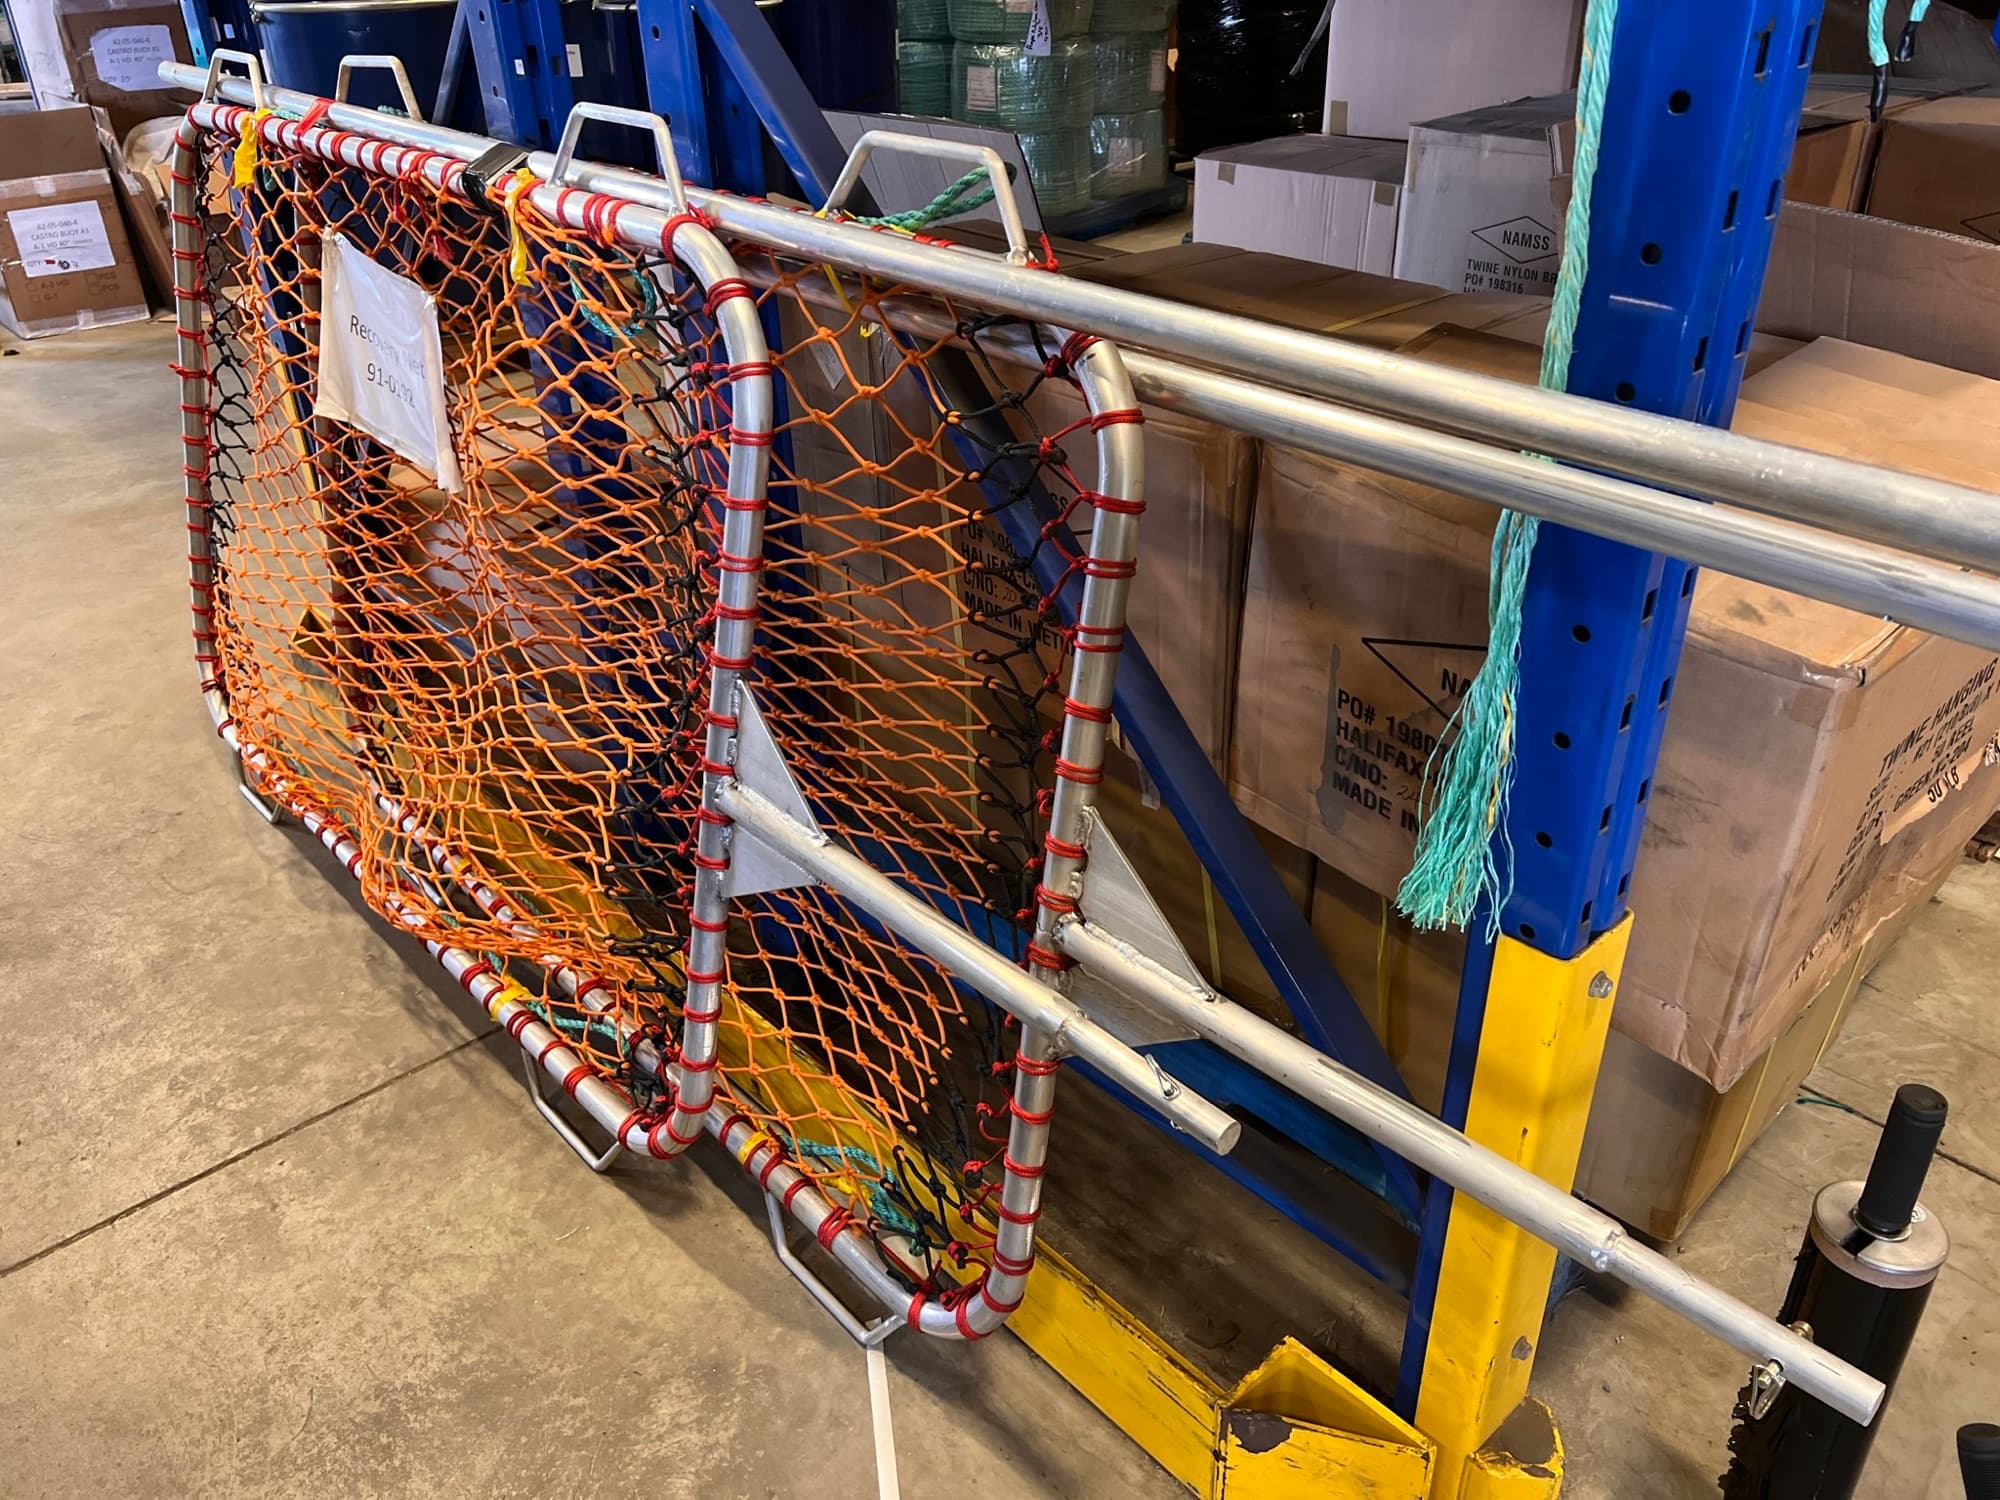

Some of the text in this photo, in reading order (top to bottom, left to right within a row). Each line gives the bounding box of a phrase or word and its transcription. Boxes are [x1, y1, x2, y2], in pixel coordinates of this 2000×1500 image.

[31, 232, 59, 241] CASTRO
[1502, 230, 1550, 251] NAMSS
[1465, 273, 1483, 287] PO#
[1489, 277, 1523, 294] 198316
[1467, 259, 1558, 285] TWINE NYLON BR
[350, 315, 398, 367] Recovery
[1009, 612, 1022, 633] IN
[1441, 667, 1472, 699] NA
[1337, 688, 1376, 726] PO#
[1879, 657, 1998, 777] TWINE HANGING
[1335, 744, 1388, 790] C/NO:
[1333, 770, 1420, 836] MADE IN
[1894, 768, 1933, 812] GREEN
